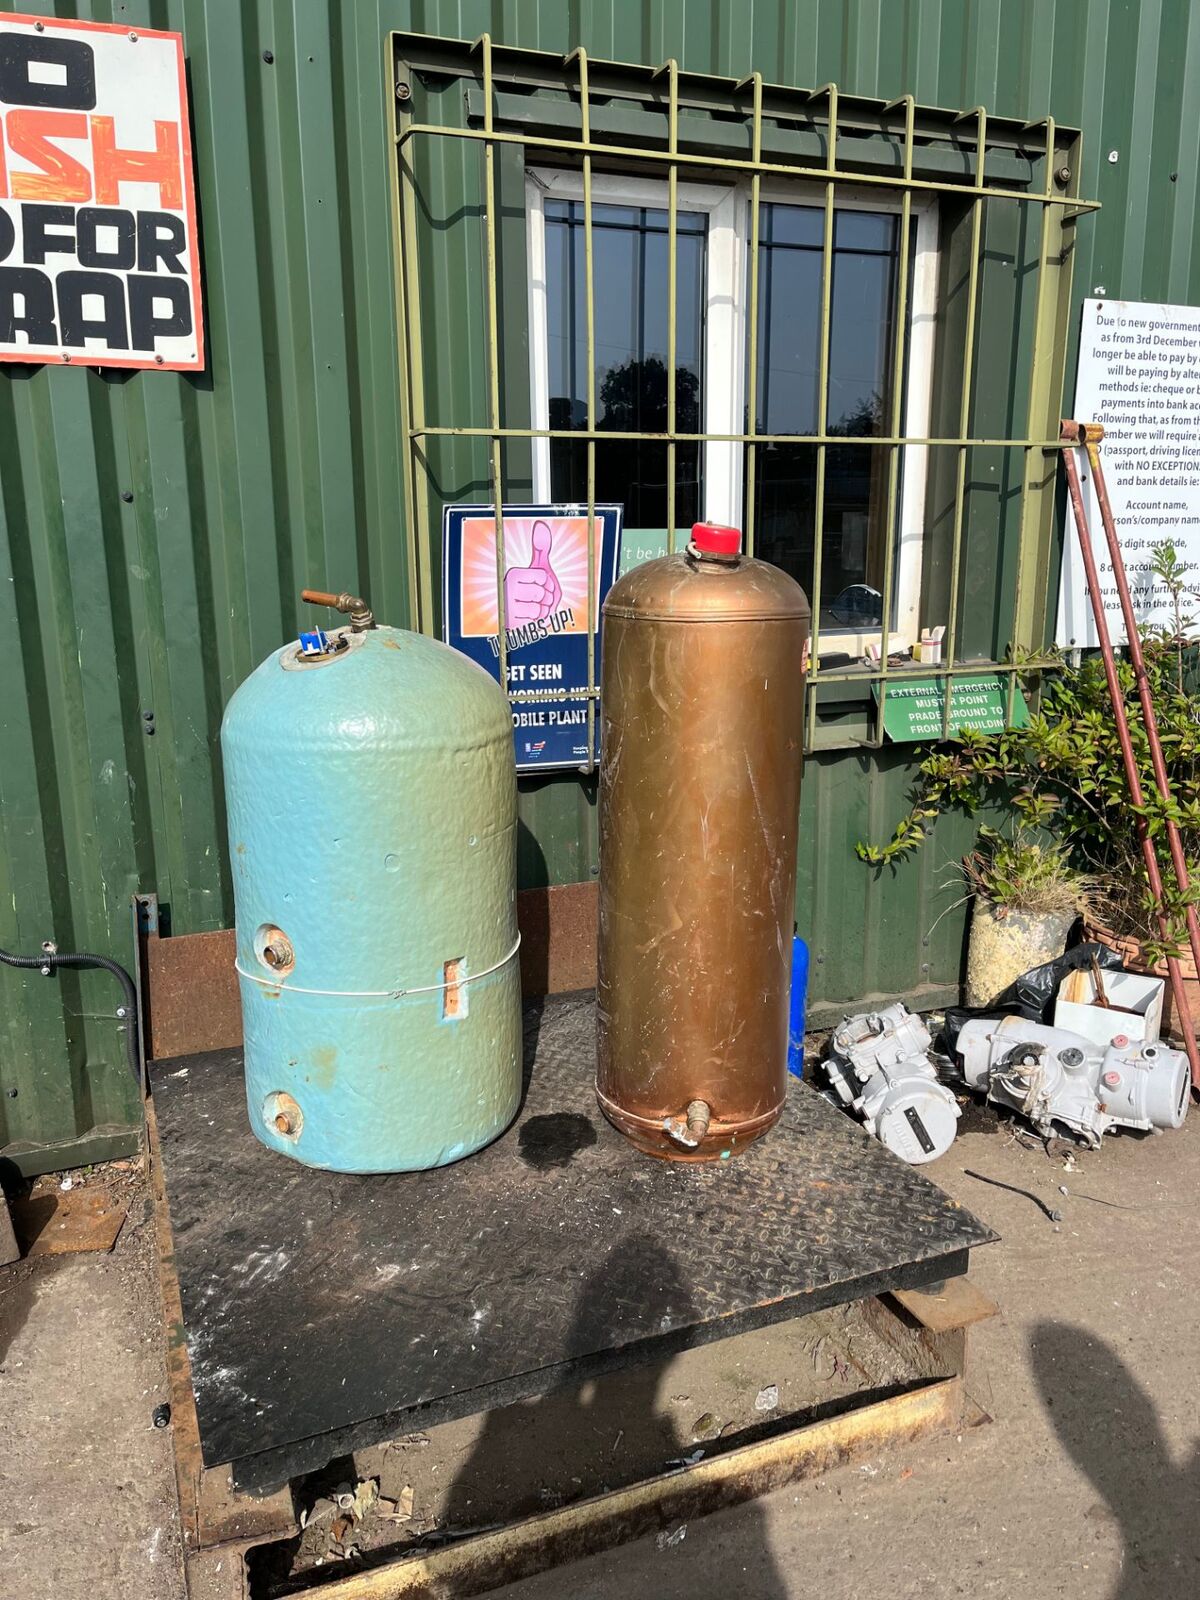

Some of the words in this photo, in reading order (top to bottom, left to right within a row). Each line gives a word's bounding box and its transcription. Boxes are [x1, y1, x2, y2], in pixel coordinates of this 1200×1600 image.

[1096, 314, 1115, 326] Due
[1128, 319, 1147, 328] new
[1101, 334, 1111, 342] as
[1113, 332, 1134, 343] from
[1136, 334, 1151, 344] 3rd
[1153, 335, 1197, 347] December
[1093, 347, 1122, 361] longer
[1124, 349, 1135, 360] be
[1137, 350, 1157, 361] able
[1158, 352, 1167, 361] to
[1169, 354, 1185, 365] pay
[1187, 353, 1198, 365] by
[1107, 364, 1124, 375] will
[1125, 365, 1137, 376] be
[1138, 366, 1169, 380] paying
[1170, 367, 1181, 380] by
[1099, 381, 1139, 392] methods
[1140, 382, 1151, 392] ie:
[1152, 383, 1184, 396] cheque
[1186, 387, 1195, 395] or
[1101, 399, 1145, 410] payments
[1147, 398, 1164, 408] into
[1166, 399, 1188, 410] bank
[1092, 412, 1136, 426] Following
[1138, 413, 1158, 425] that,
[1160, 417, 1169, 425] as
[1171, 414, 1191, 425] from
[1104, 429, 1132, 439] ember
[1135, 431, 1147, 439] we
[1149, 429, 1165, 440] will
[1166, 430, 1197, 443] require
[1104, 444, 1148, 457] (passport,
[1149, 445, 1180, 458] driving
[1114, 460, 1134, 470] with
[1136, 460, 1150, 470] NO
[1152, 461, 1200, 471] EXCEPTION
[1117, 475, 1134, 486] and
[1136, 475, 1157, 486] bank
[1160, 475, 1188, 486] details
[1189, 476, 1200, 486] ie:
[1125, 500, 1162, 510] Account
[1162, 501, 1188, 511] name,
[1124, 538, 1145, 550] digit
[637, 547, 653, 560] be
[1100, 562, 1105, 572] 8
[1134, 586, 1150, 596] any
[1143, 599, 1151, 608] in
[1153, 599, 1167, 608] the
[550, 607, 575, 635] UP!
[529, 664, 563, 680] SEEN
[890, 686, 942, 698] EXTERNAL
[950, 682, 1004, 694] MERGENCY
[915, 698, 957, 709] MUSTR
[959, 695, 988, 704] POINT
[512, 711, 546, 728] OBILE
[549, 709, 587, 726] PLANT
[908, 710, 942, 721] PRADE
[990, 706, 1004, 715] TO
[910, 723, 943, 734] FRONT
